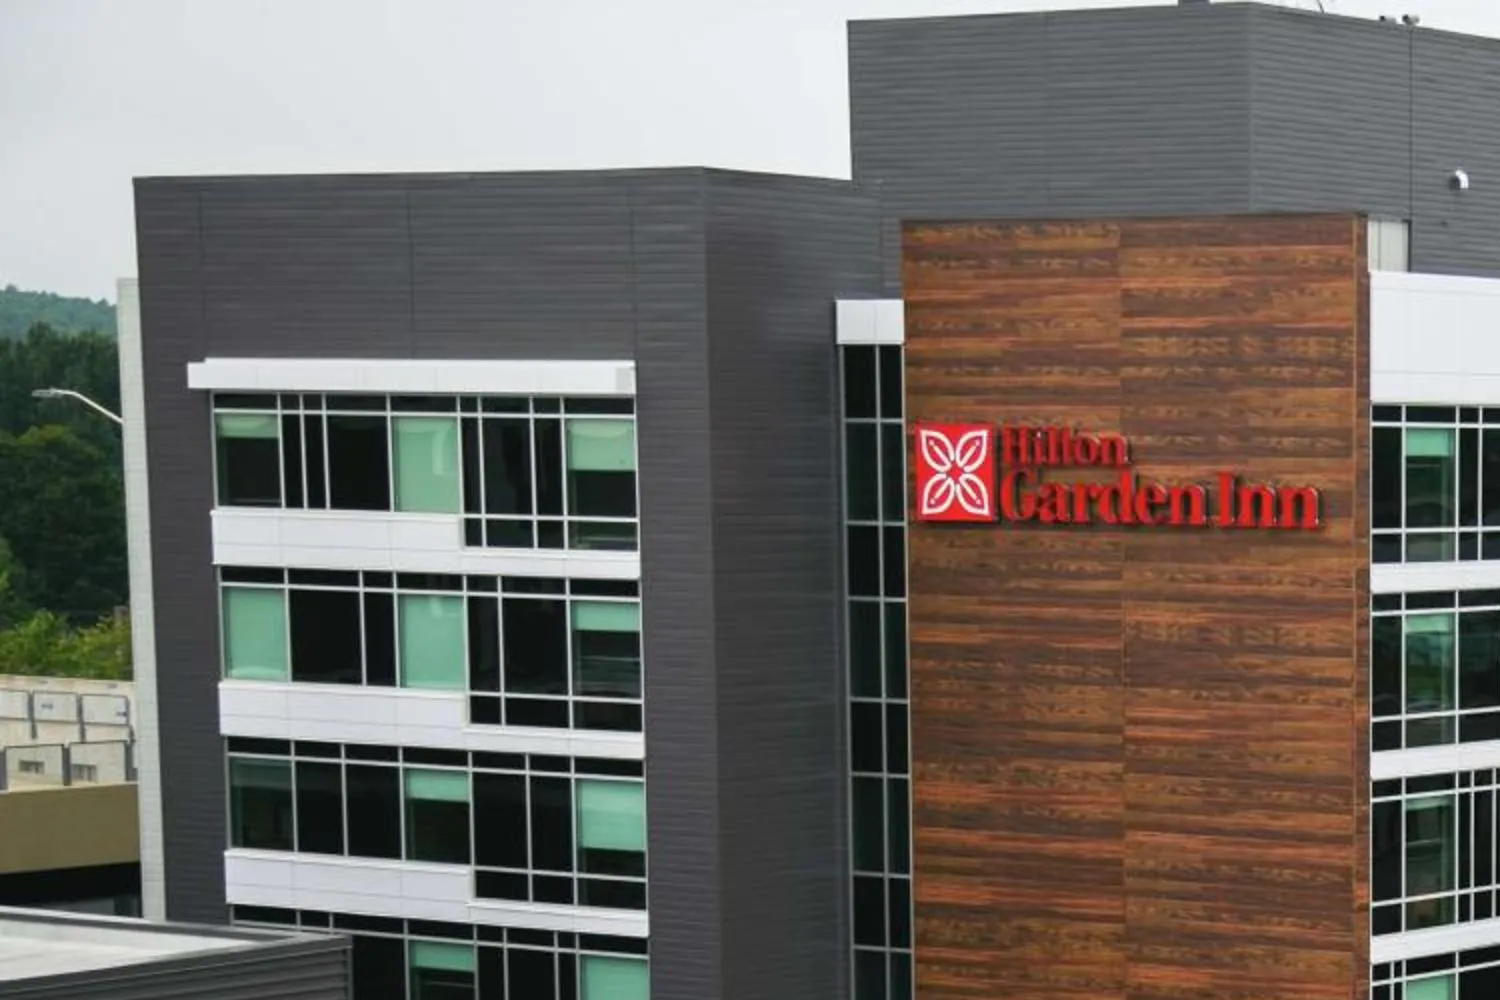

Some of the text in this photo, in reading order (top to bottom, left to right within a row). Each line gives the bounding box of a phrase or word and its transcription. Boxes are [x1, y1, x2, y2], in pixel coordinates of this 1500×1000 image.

[1001, 425, 1128, 465] Hilton
[1001, 468, 1319, 530] Garden Inn
